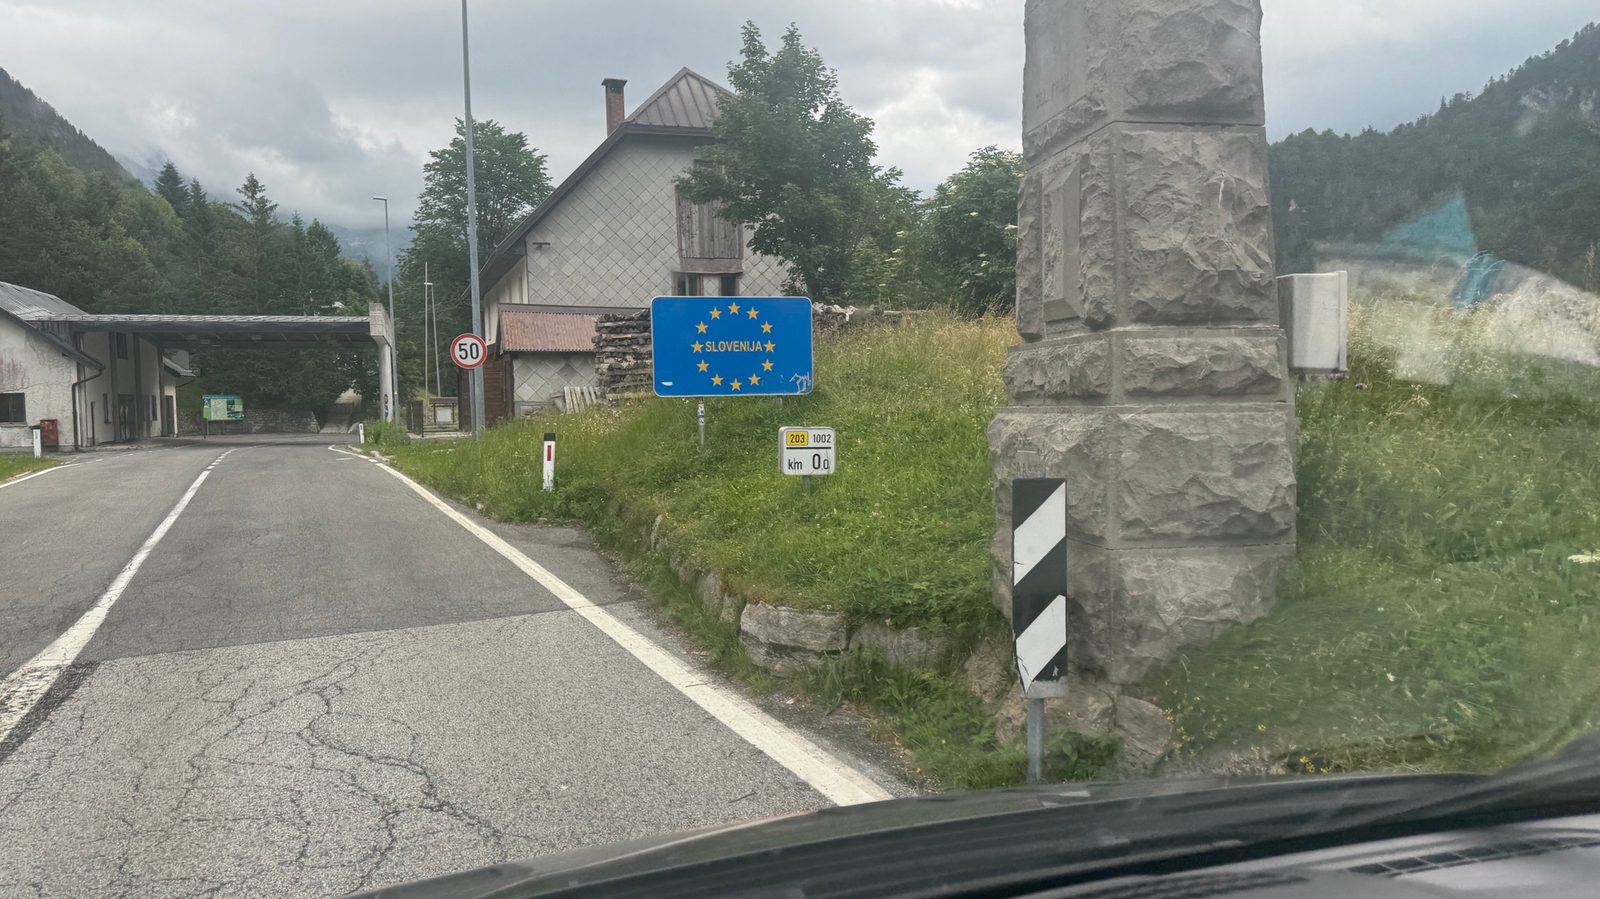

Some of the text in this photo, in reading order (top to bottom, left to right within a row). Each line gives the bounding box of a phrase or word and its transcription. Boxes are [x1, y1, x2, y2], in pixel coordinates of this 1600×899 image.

[458, 343, 479, 360] 50
[705, 341, 763, 352] SLOVENIJA
[790, 434, 831, 443] 203 1002
[788, 459, 803, 470] km
